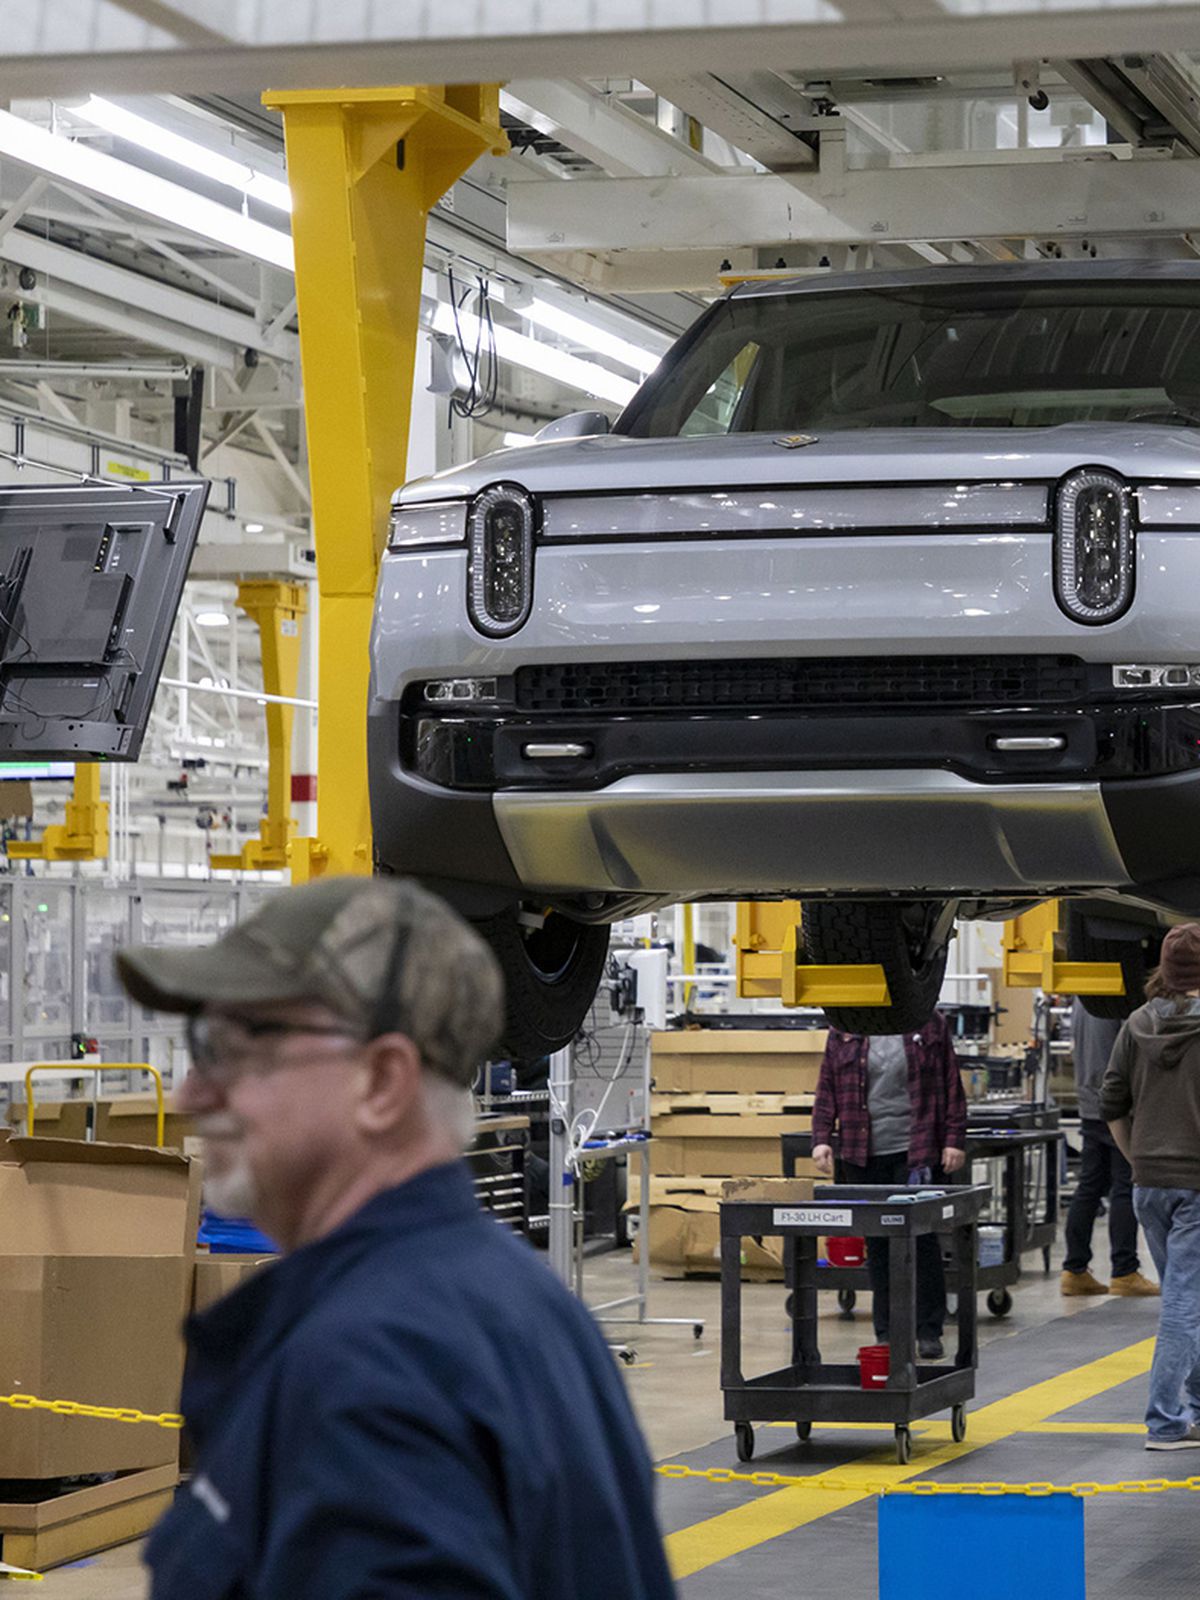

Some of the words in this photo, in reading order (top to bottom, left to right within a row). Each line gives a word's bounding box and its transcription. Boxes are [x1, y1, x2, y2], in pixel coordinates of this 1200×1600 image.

[781, 1212, 806, 1222] F1-30
[808, 1212, 821, 1222] LH
[823, 1212, 844, 1222] Cart
